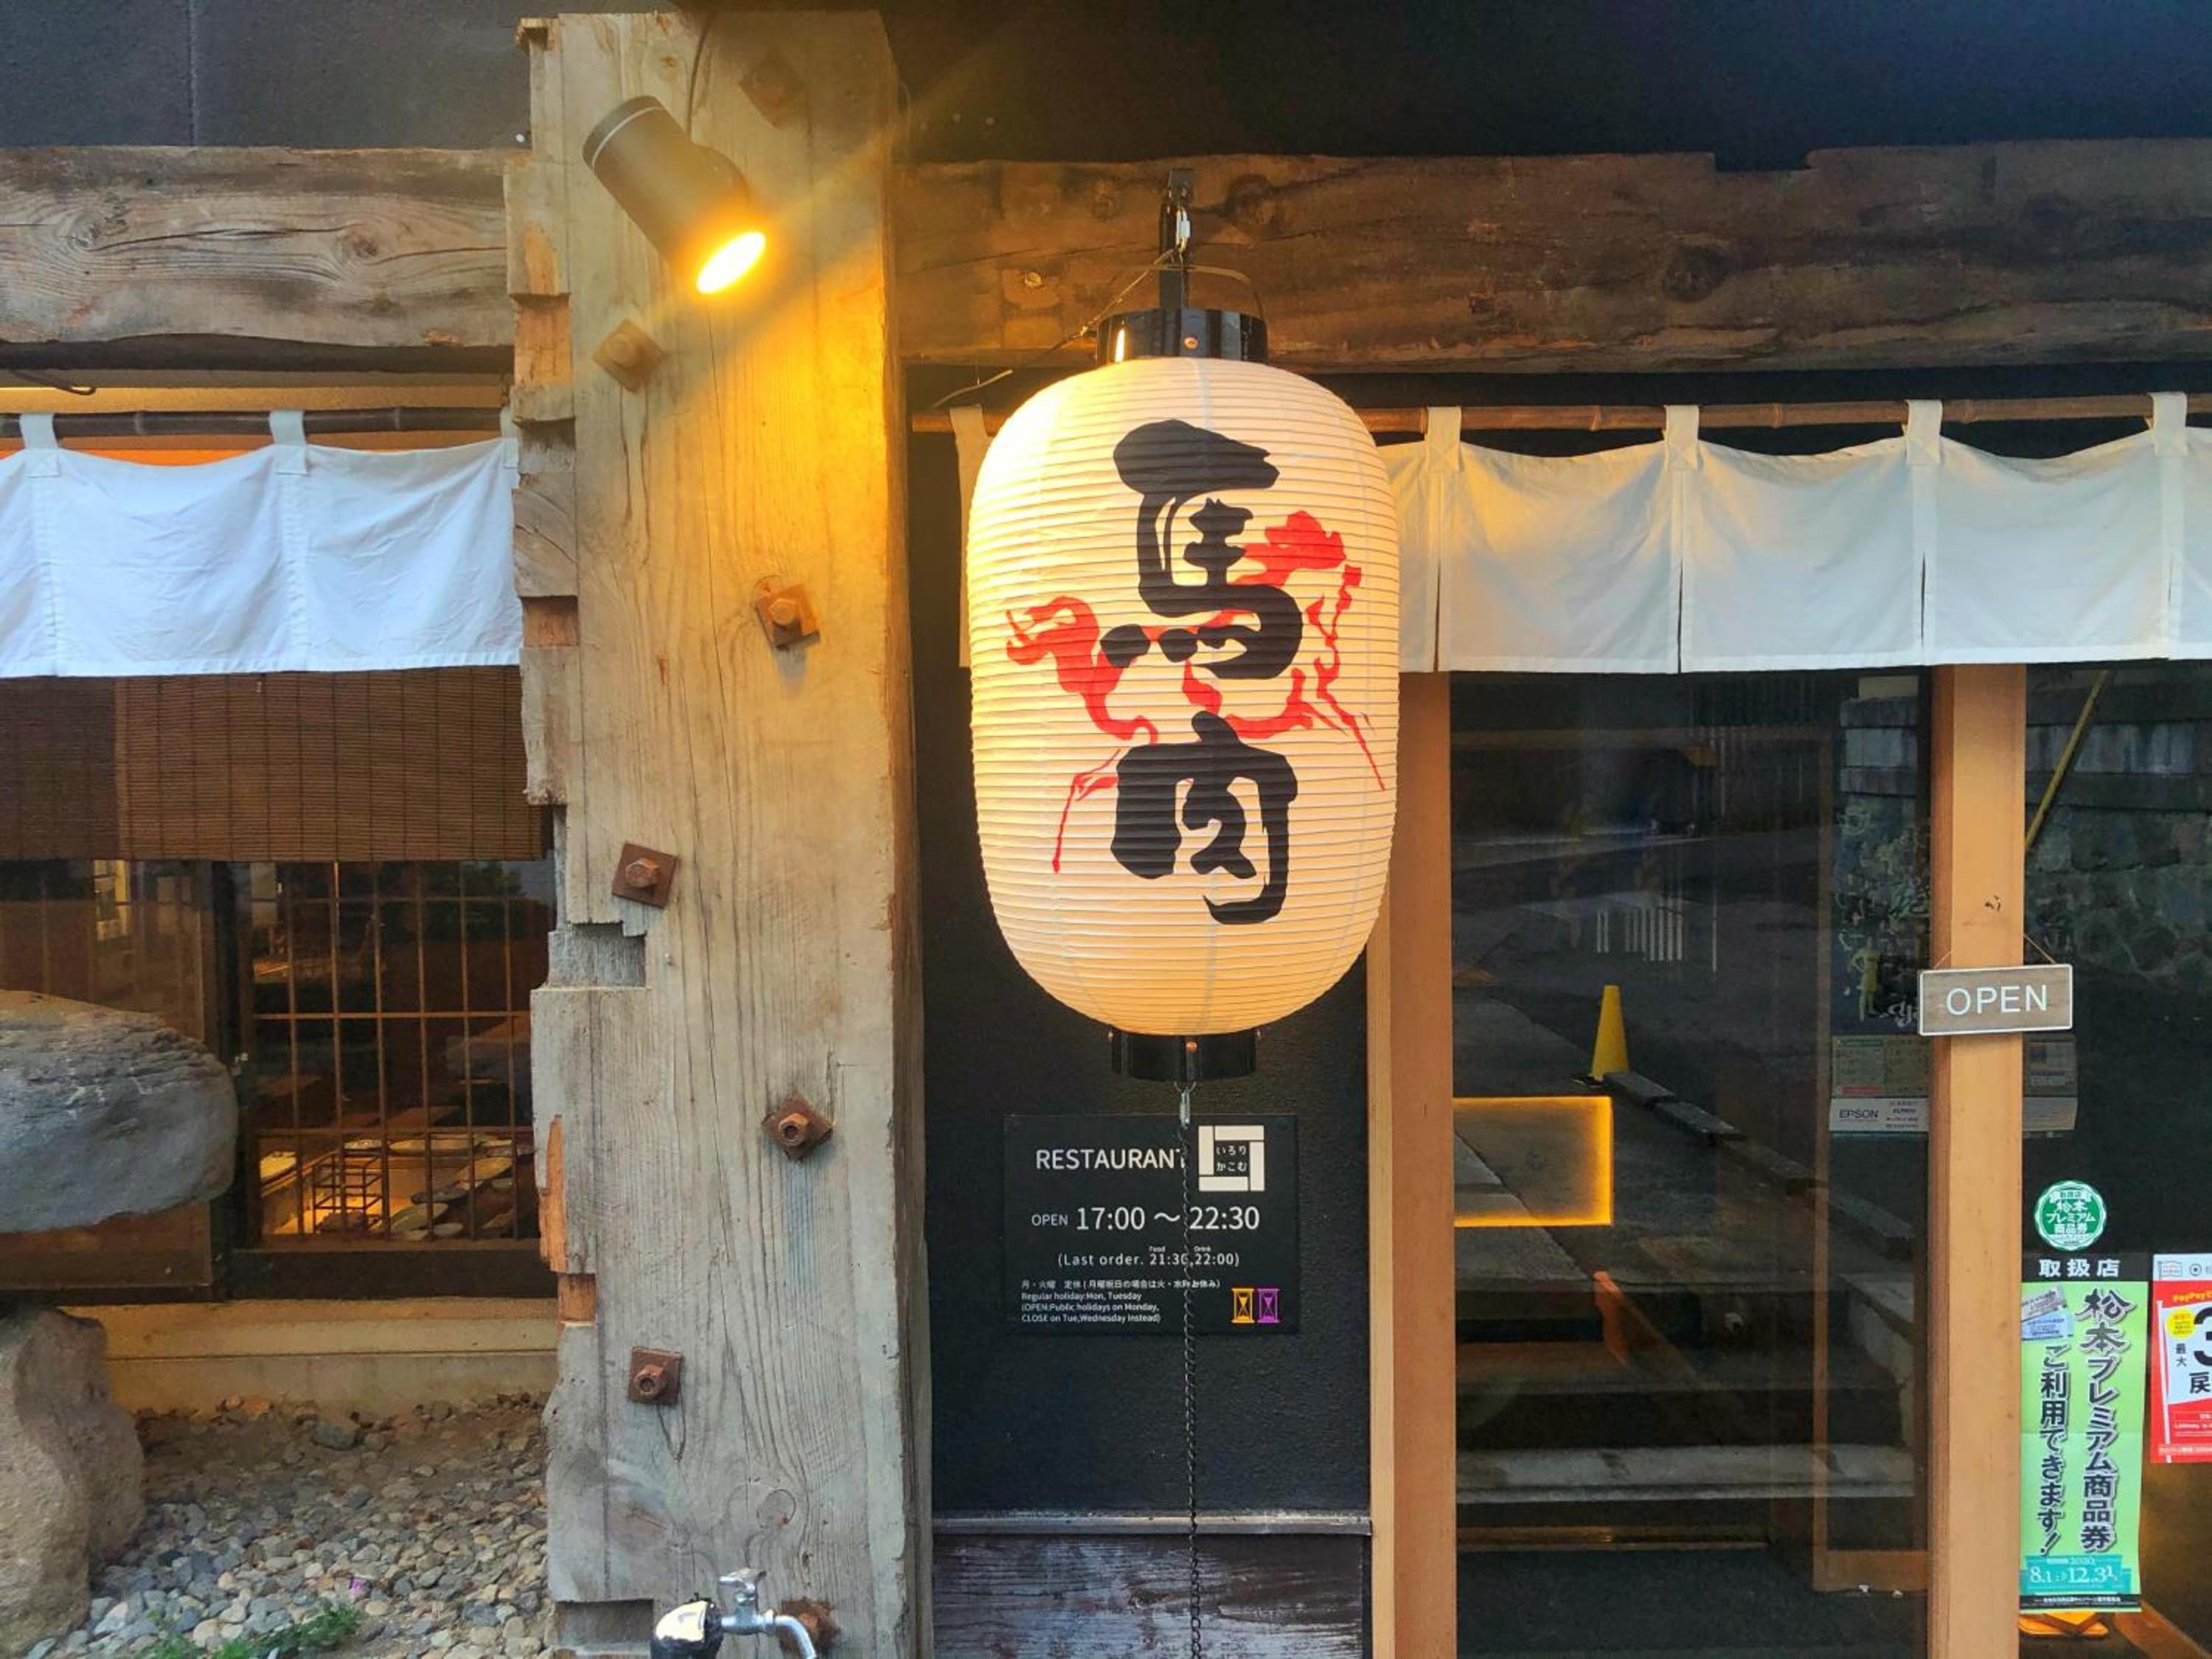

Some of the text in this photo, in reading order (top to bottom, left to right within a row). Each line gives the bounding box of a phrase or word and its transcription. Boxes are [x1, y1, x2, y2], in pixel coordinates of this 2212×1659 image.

[1099, 419, 1304, 925] 馬肉
[1946, 984, 2048, 1015] OPEN
[1840, 1109, 1879, 1119] EPSON
[1216, 1145, 1247, 1156] いろり
[1216, 1161, 1247, 1172] かこむ
[1032, 1214, 1068, 1226] OPEN
[1077, 1207, 1145, 1230] 17:00
[1189, 1206, 1260, 1230] 22:30
[1058, 1253, 1093, 1267] (Last
[1099, 1253, 1144, 1265] order.
[2039, 1259, 2120, 1277] 取扱店
[1021, 1293, 1052, 1302] Regular
[1107, 1292, 1142, 1301] Tuesday
[1077, 1303, 1110, 1312] holidays
[1021, 1314, 1048, 1322] CLOSE
[1127, 1313, 1161, 1323] instead)
[2075, 1287, 2132, 1550] 松本プレミアム商品券
